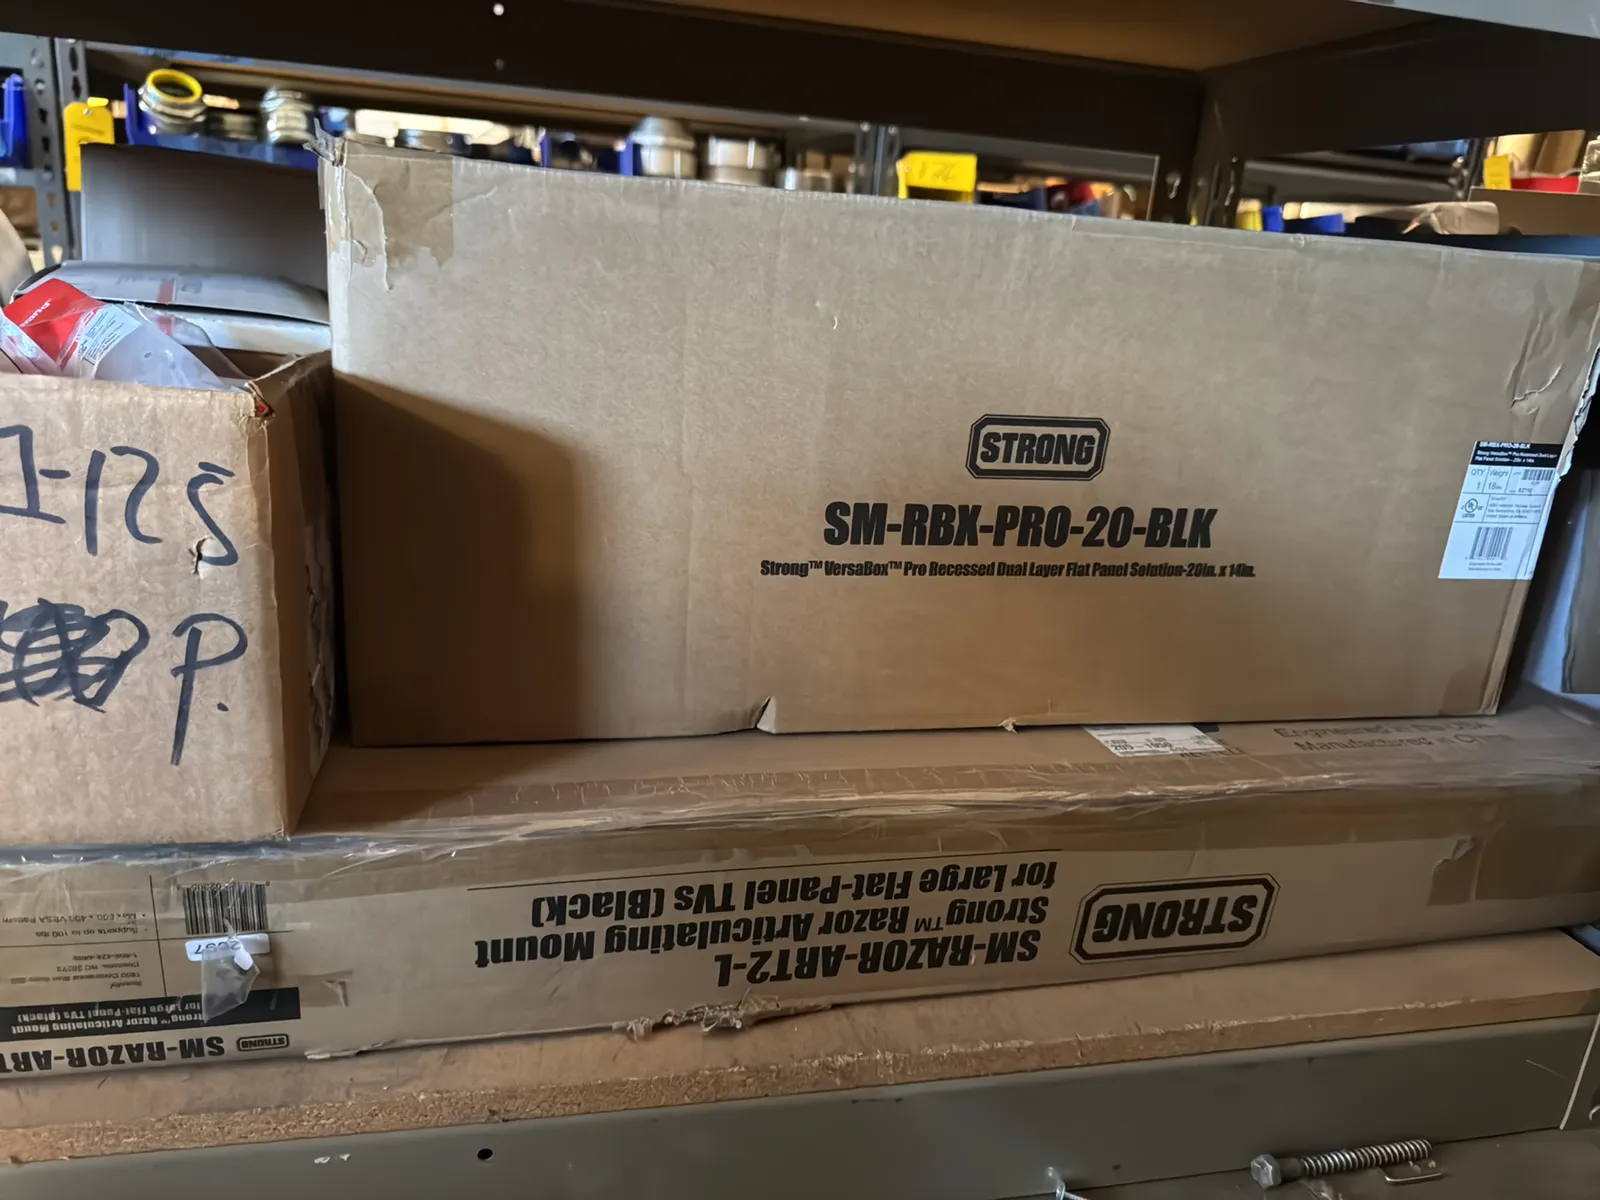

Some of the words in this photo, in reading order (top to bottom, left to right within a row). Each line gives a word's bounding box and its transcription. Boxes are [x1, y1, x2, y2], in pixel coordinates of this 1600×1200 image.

[980, 432, 1097, 466] STRONG
[1471, 469, 1485, 477] QTY
[1489, 469, 1509, 478] Weight
[823, 501, 1219, 549] SM-RBX-PRO-20-BLK
[903, 561, 927, 577] Pro
[929, 561, 995, 577] Recessed
[997, 562, 1028, 577] Dual
[1029, 562, 1066, 578] Layer
[1067, 562, 1090, 577] Flat
[1092, 562, 1128, 577] Panel
[1218, 565, 1227, 577] x
[743, 870, 911, 912] Flat-Panel
[918, 864, 1002, 896] Large
[1011, 861, 1058, 890] for
[531, 886, 664, 928] (Black)
[673, 881, 736, 915] TVs
[604, 911, 816, 957] Articulating
[819, 906, 911, 939] Razor
[1091, 895, 1259, 943] STRONG
[474, 930, 596, 968] Mount
[714, 929, 1042, 988] SM-RAZOR-ART2-L
[12, 1024, 50, 1035] Mount
[52, 1017, 124, 1032] Articulating
[63, 1009, 86, 1019] TVs
[126, 1016, 159, 1026] Razor
[241, 1036, 287, 1050] STRONG
